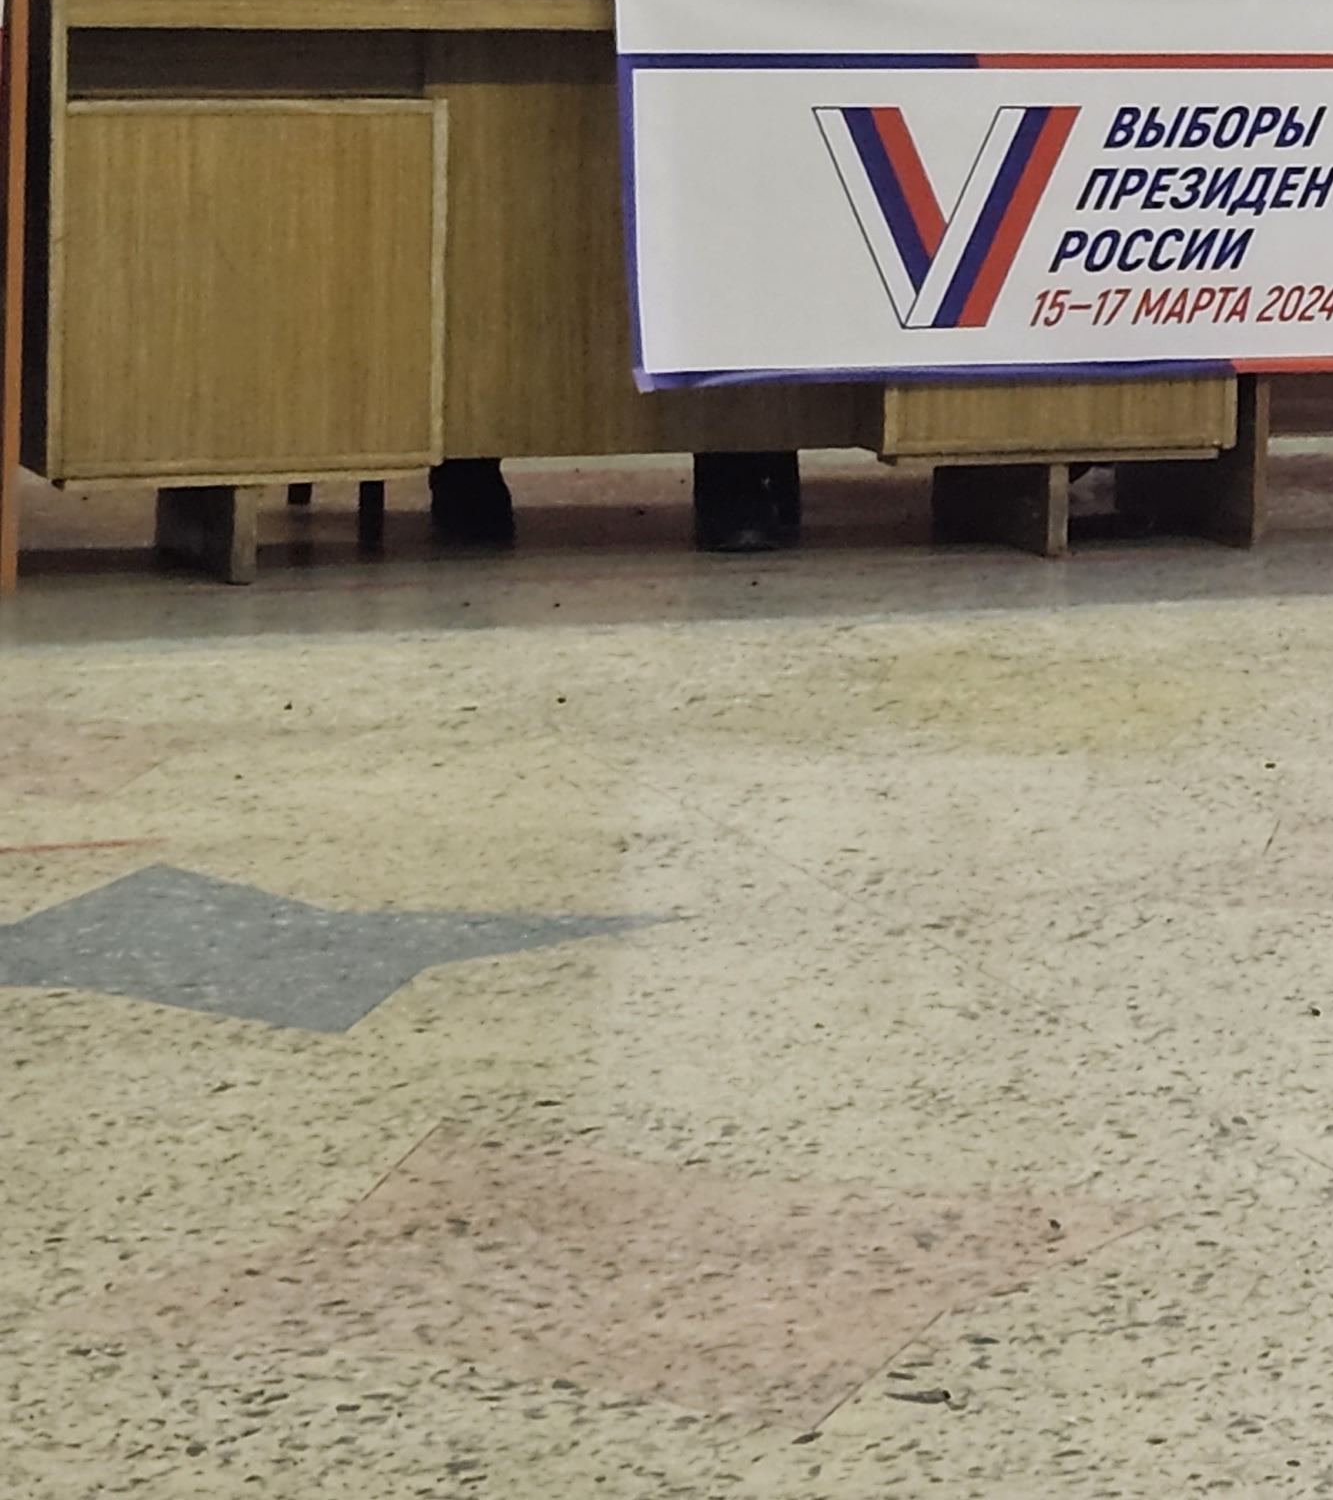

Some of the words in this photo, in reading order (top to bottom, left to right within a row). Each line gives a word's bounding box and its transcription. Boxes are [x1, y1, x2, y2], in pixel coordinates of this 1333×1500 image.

[1103, 105, 1328, 149] ВЫБОРЫ
[1048, 228, 1255, 273] РОССИИ
[1131, 286, 1253, 325] МАРТА
